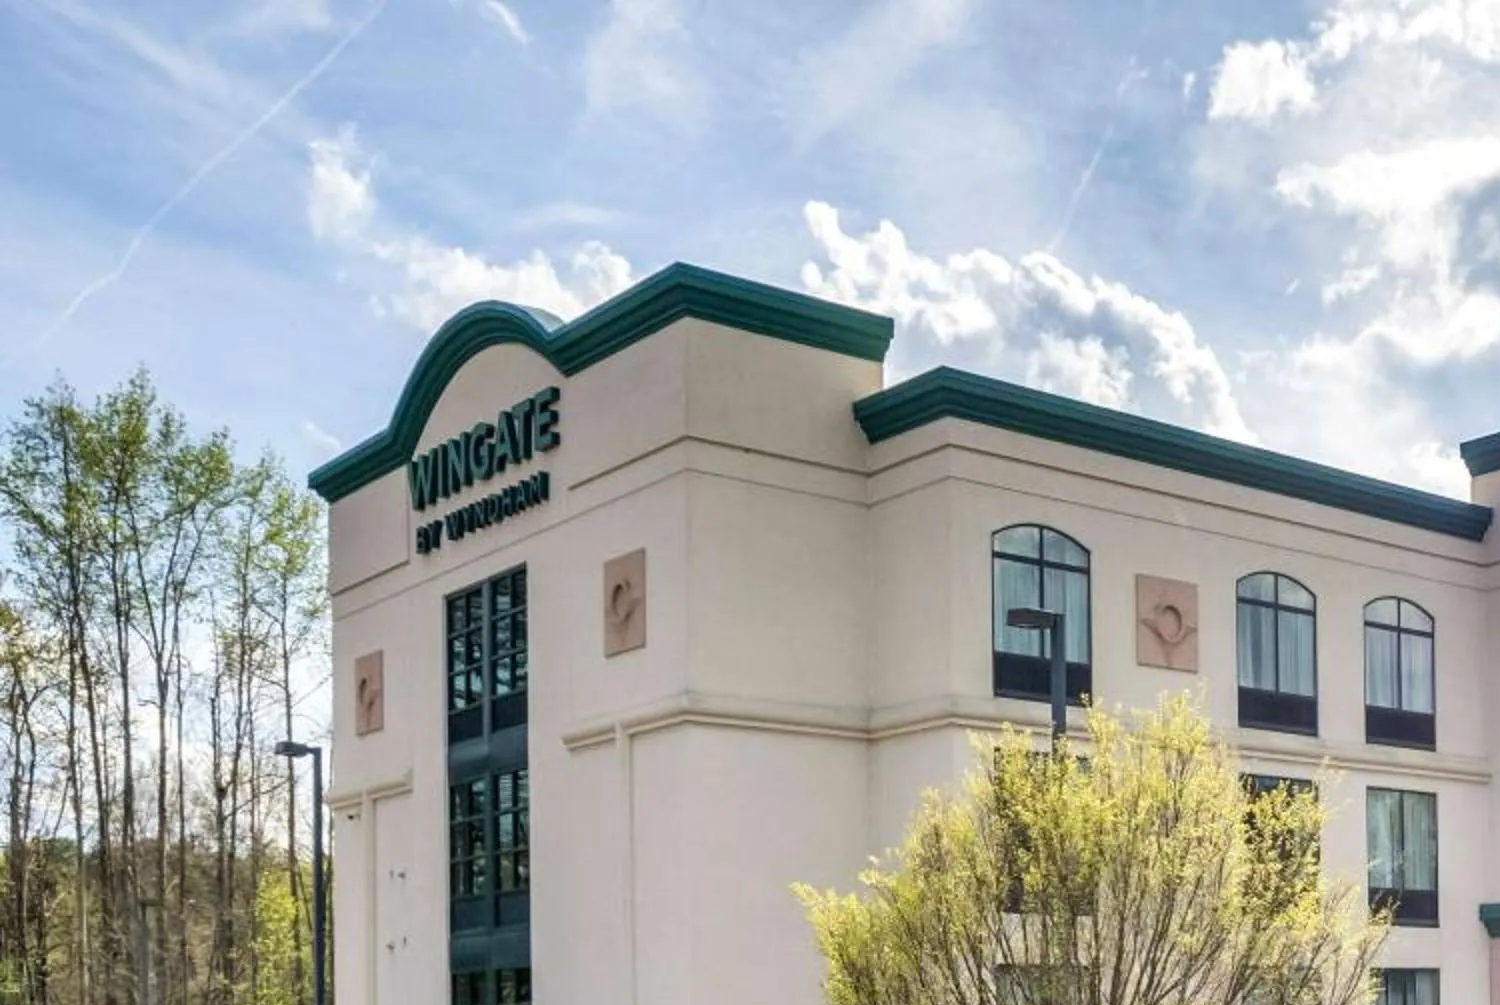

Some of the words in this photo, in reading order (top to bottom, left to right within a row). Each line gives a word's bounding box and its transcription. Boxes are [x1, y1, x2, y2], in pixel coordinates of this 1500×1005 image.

[407, 386, 561, 512] WINGATE
[416, 520, 443, 555] BY
[444, 470, 550, 541] WYNDHAM
